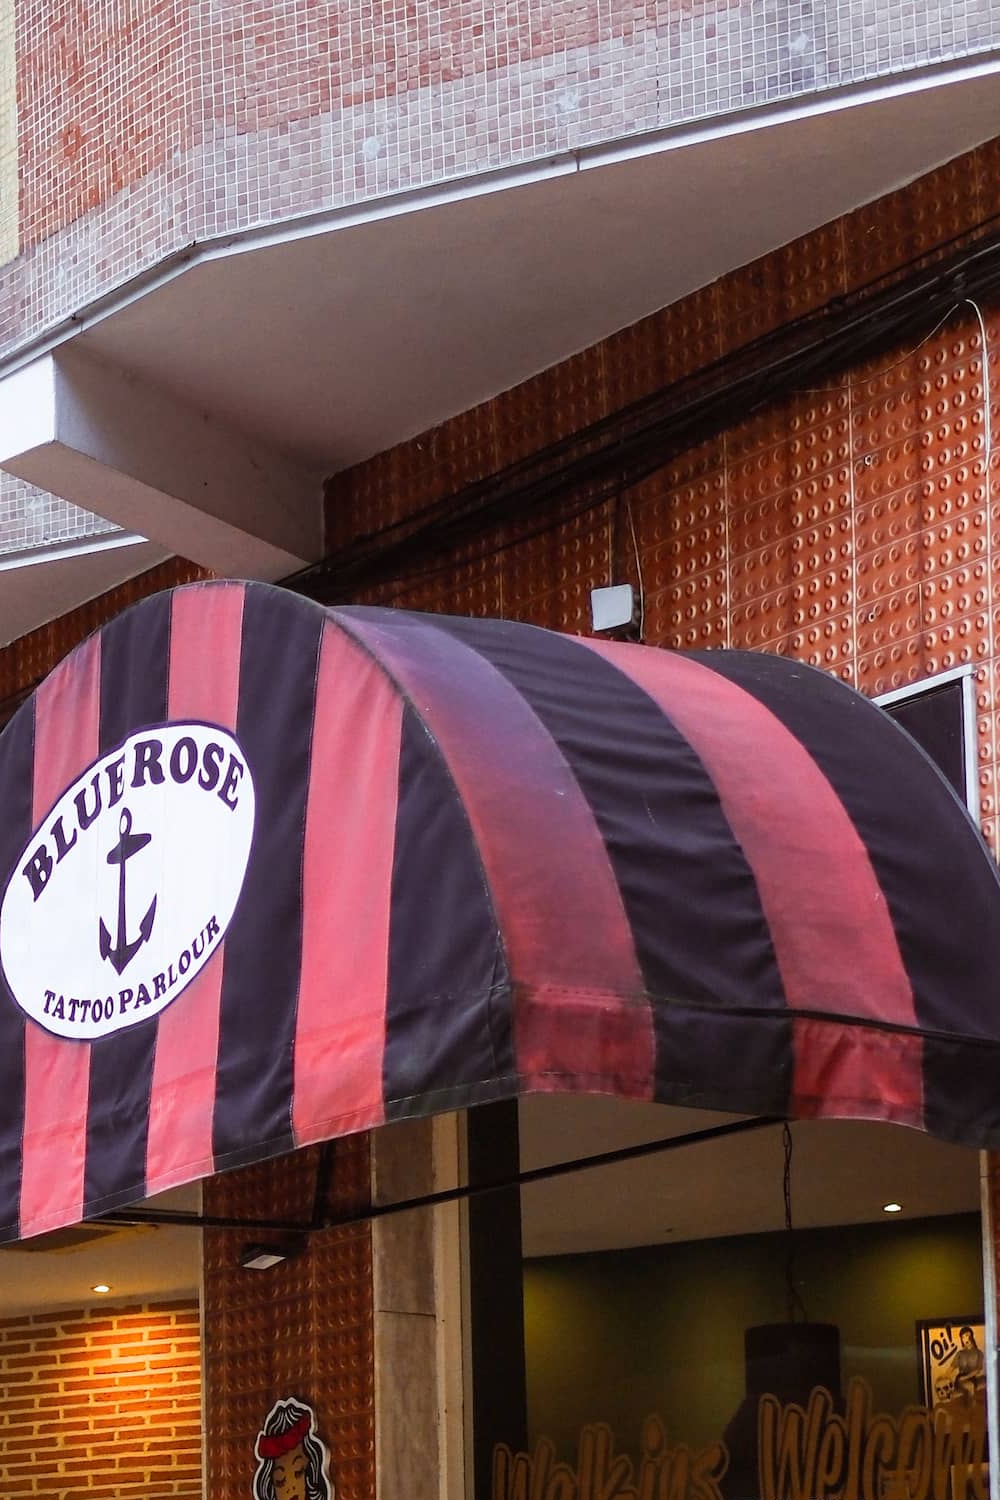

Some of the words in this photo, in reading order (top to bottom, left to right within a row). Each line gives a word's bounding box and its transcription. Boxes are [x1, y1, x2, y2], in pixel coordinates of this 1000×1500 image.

[21, 753, 126, 903] BLUE
[130, 736, 245, 812] ROSE
[43, 989, 114, 1024] TATTOO
[118, 914, 221, 1014] PARLOUR
